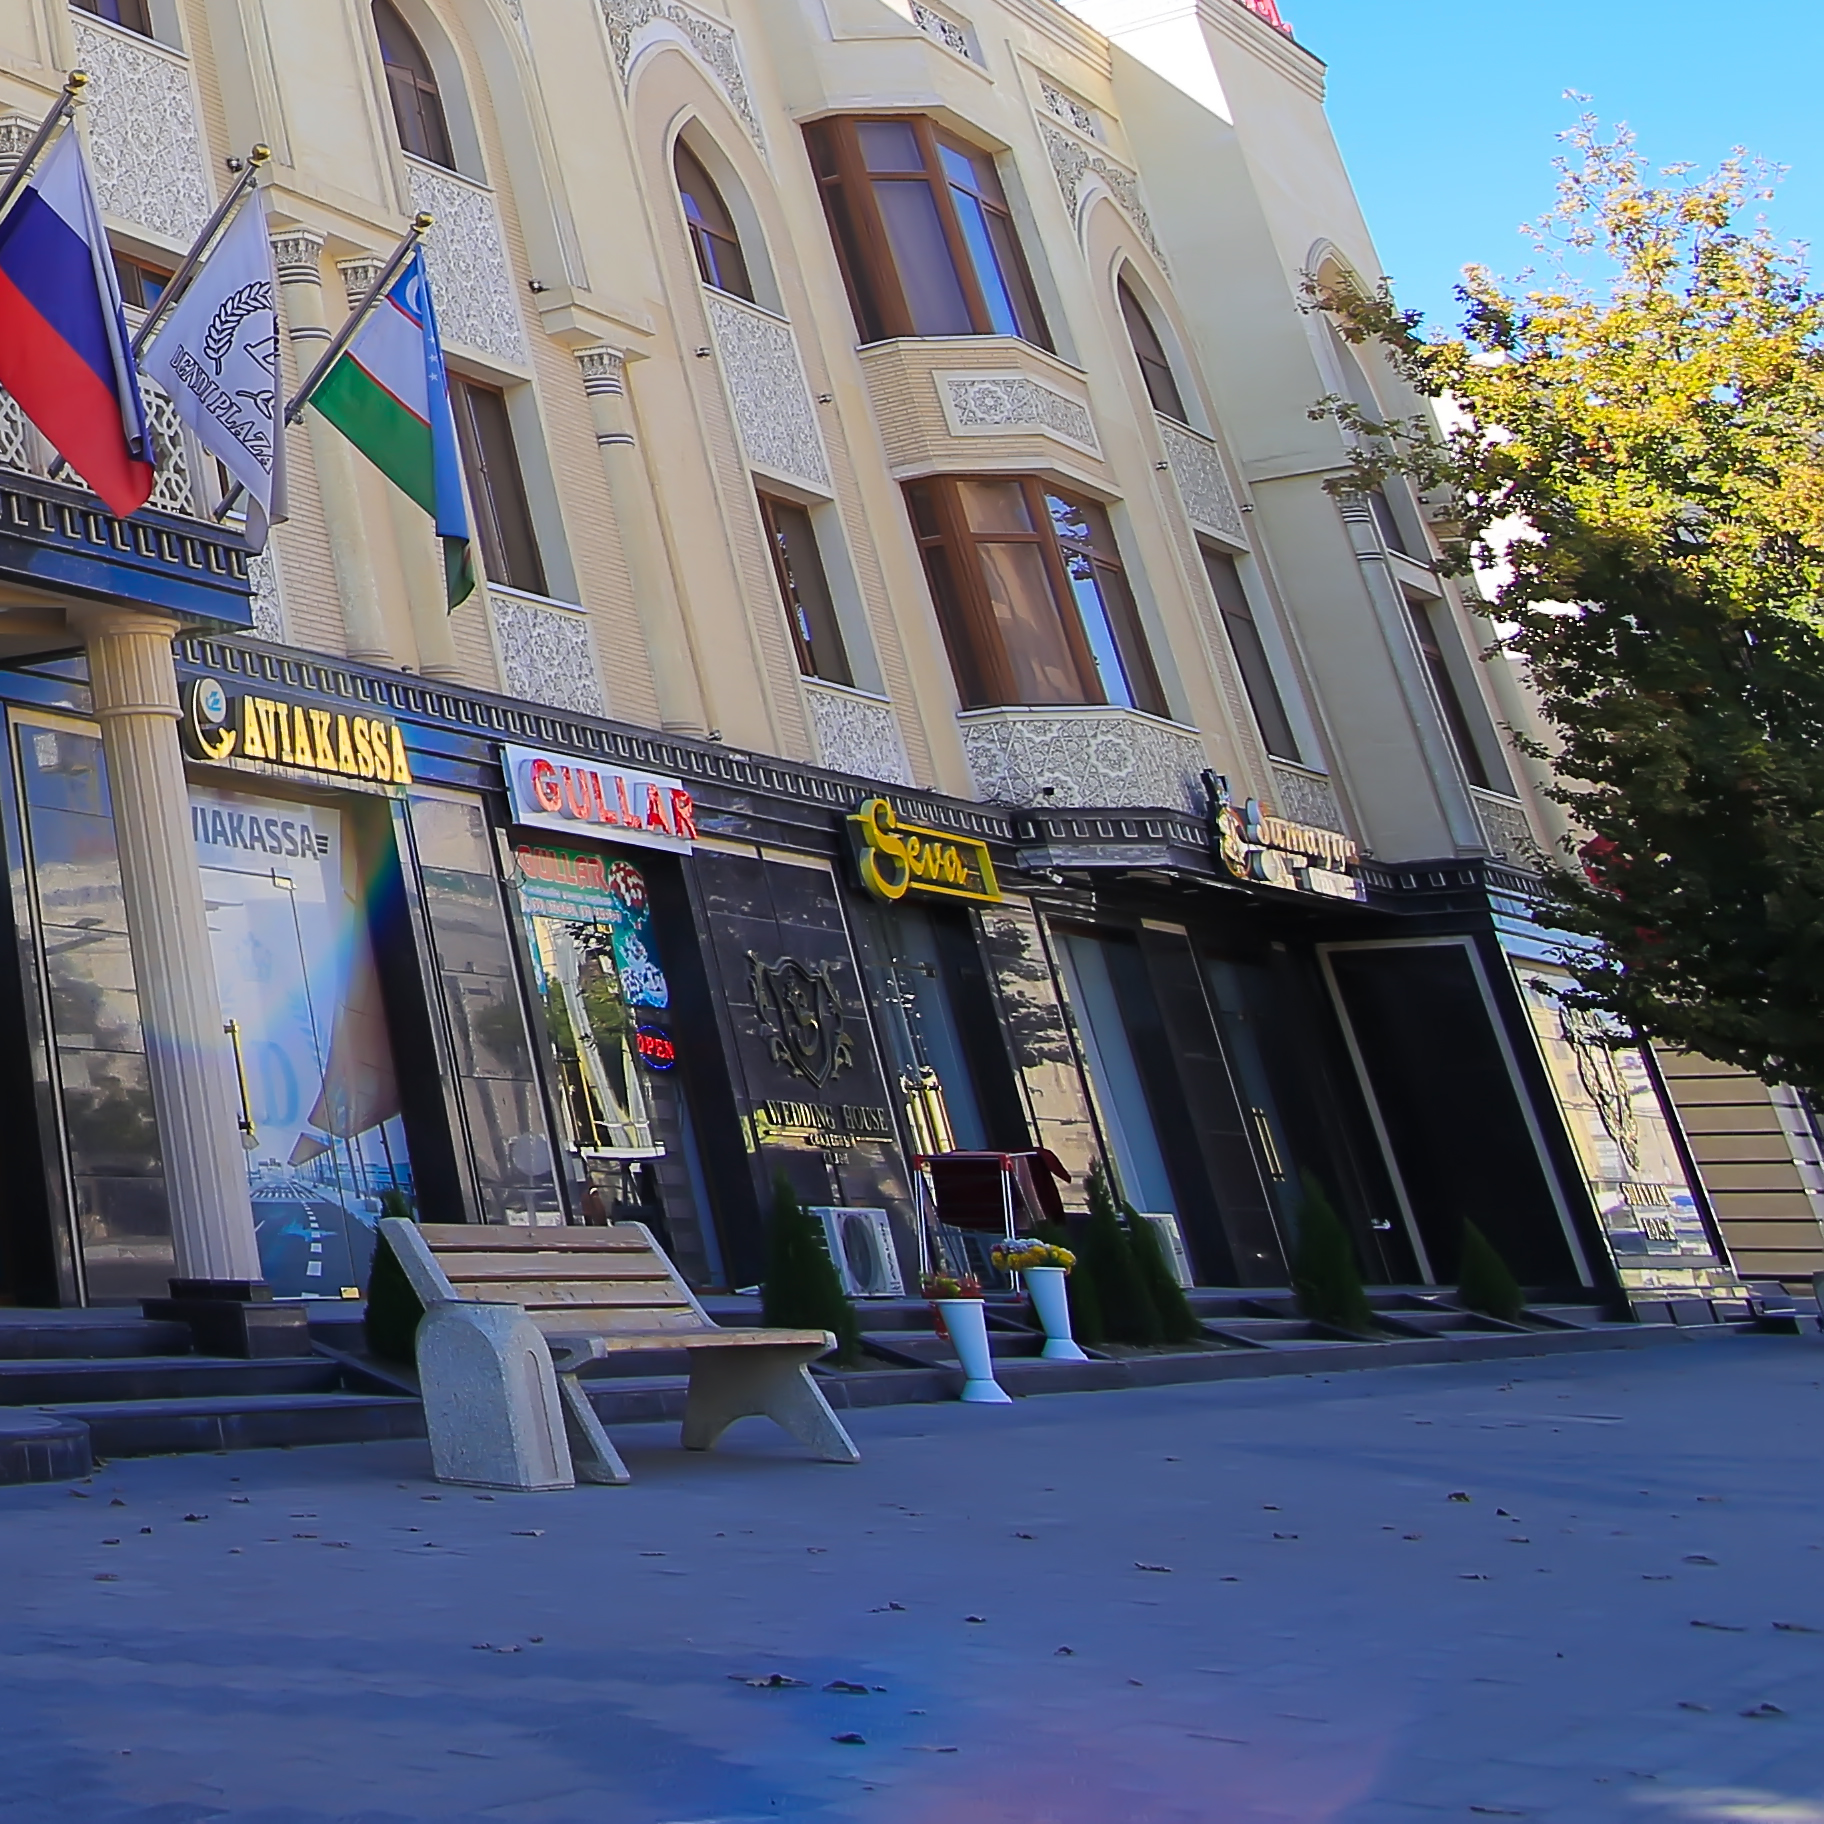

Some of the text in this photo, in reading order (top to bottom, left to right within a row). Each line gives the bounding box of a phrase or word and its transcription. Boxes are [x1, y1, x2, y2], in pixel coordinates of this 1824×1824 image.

[170, 343, 220, 404] DENDI
[242, 694, 413, 785] AVIAKASSA
[528, 758, 699, 840] GULLAR
[516, 844, 610, 894] GULLAR
[860, 798, 969, 900] Seva
[636, 1033, 675, 1060] OPEN
[765, 1099, 889, 1131] WEDDING HOUSE
